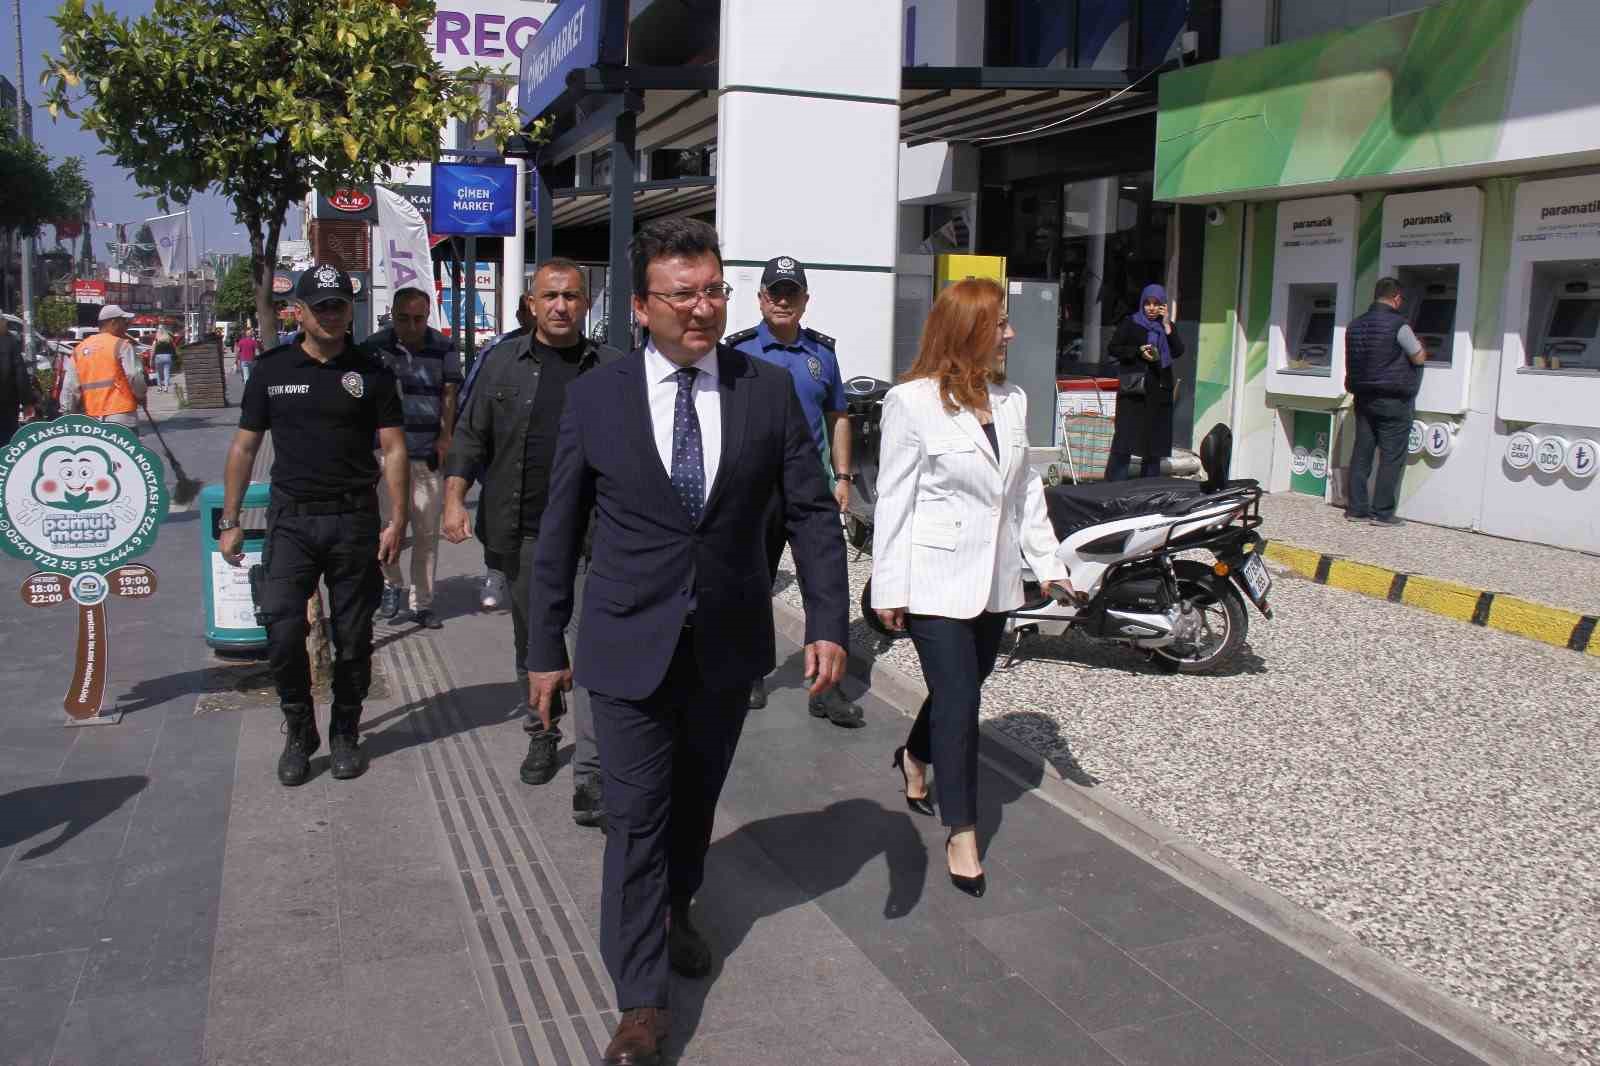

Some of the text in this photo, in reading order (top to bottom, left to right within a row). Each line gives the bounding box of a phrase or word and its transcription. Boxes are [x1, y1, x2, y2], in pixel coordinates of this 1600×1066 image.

[550, 4, 585, 74] MARKET
[457, 185, 490, 200] ÇİMEN
[452, 200, 494, 211] MARKET
[1293, 216, 1332, 232] paramatik
[1402, 212, 1453, 228] paramatik
[284, 384, 311, 394] KUVVET
[4, 424, 159, 504] ÇÖP TAKSİ TOPLAMA NOKTASI
[43, 513, 116, 537] pamuk
[50, 529, 109, 544] masa
[132, 536, 142, 547] 9
[5, 529, 96, 571] 0540 722 55 55
[118, 575, 149, 586] 19:00
[29, 583, 60, 594] 18:00
[119, 585, 151, 596] 23:00
[31, 593, 62, 604] 22:00
